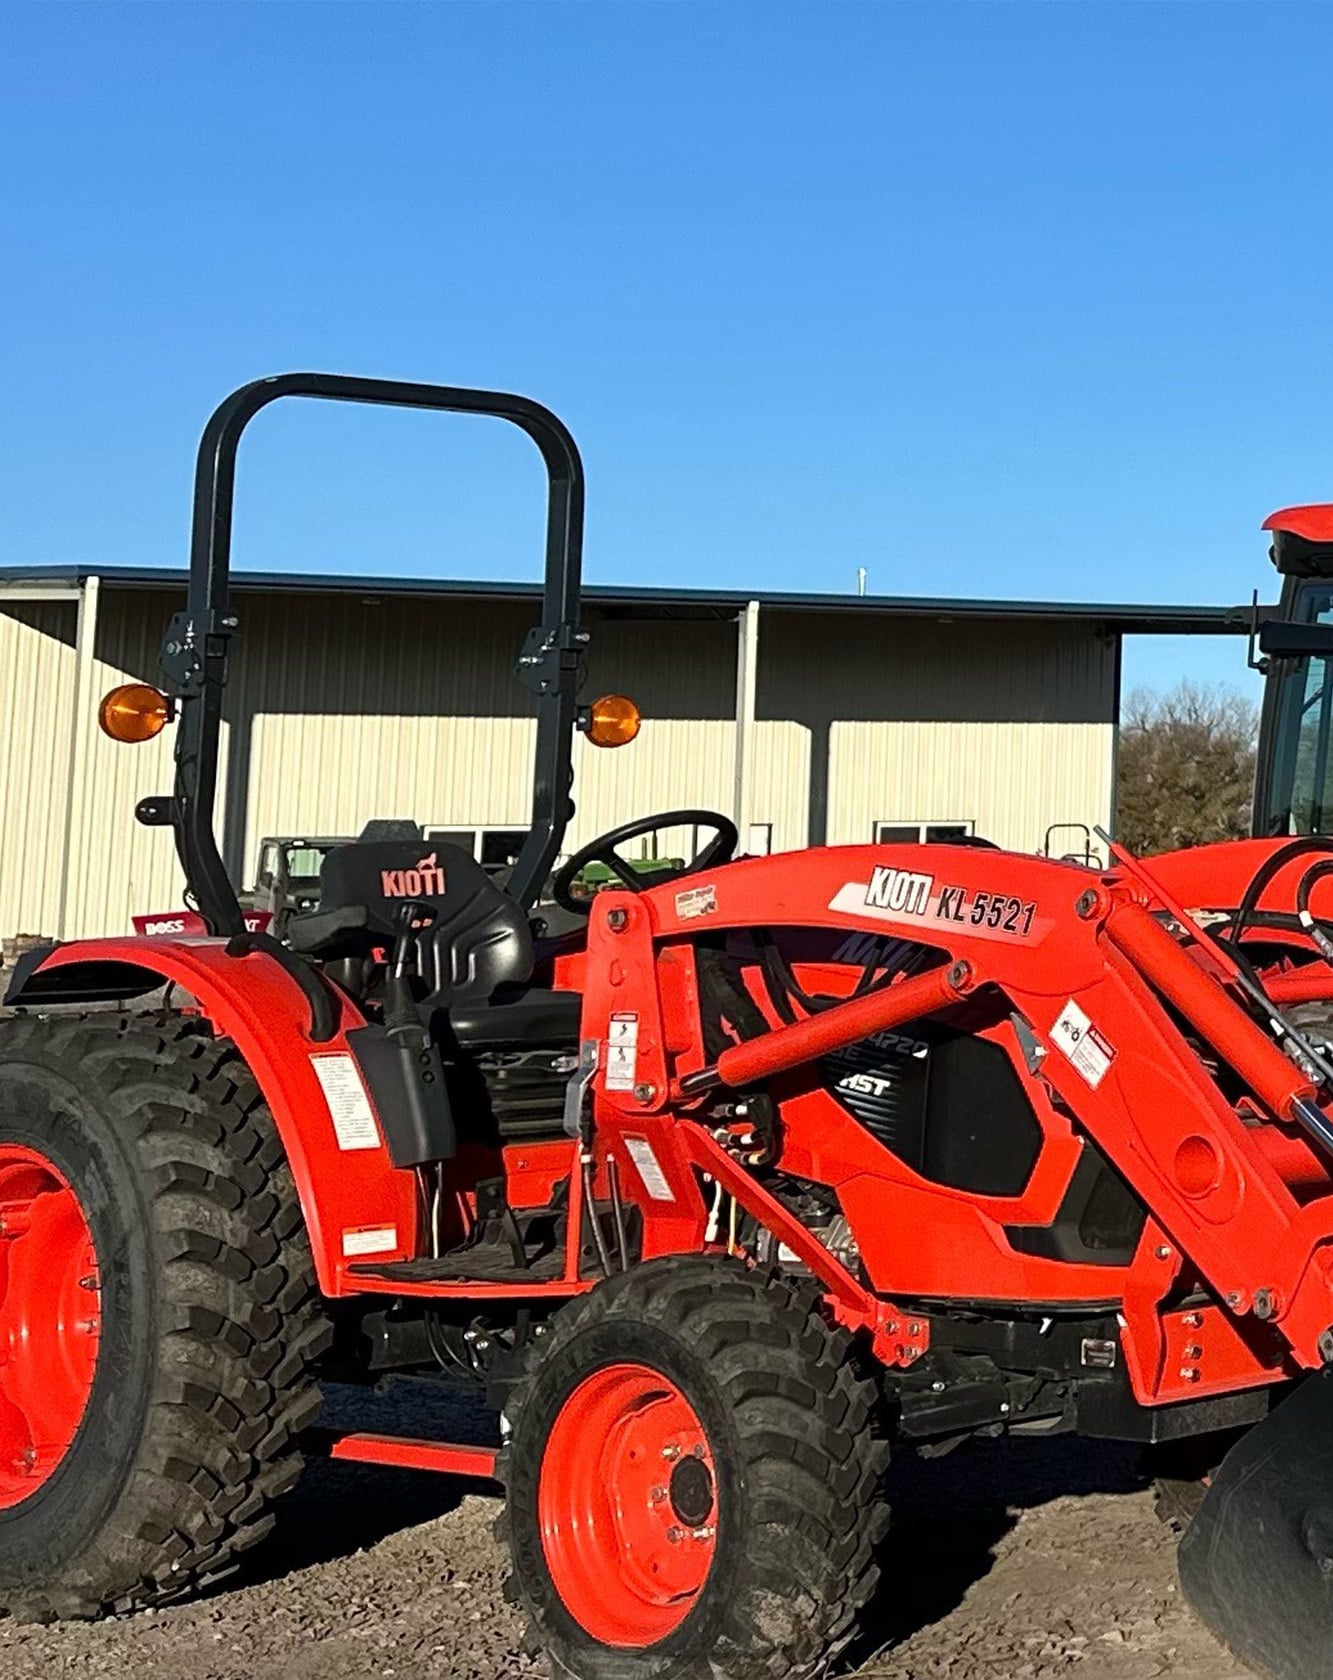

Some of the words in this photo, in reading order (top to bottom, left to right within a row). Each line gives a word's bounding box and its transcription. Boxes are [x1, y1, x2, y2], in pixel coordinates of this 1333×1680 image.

[380, 866, 446, 898] KIOTI
[864, 865, 934, 916] KIOTI
[936, 886, 1037, 936] KL5521
[145, 919, 185, 936] BOSS
